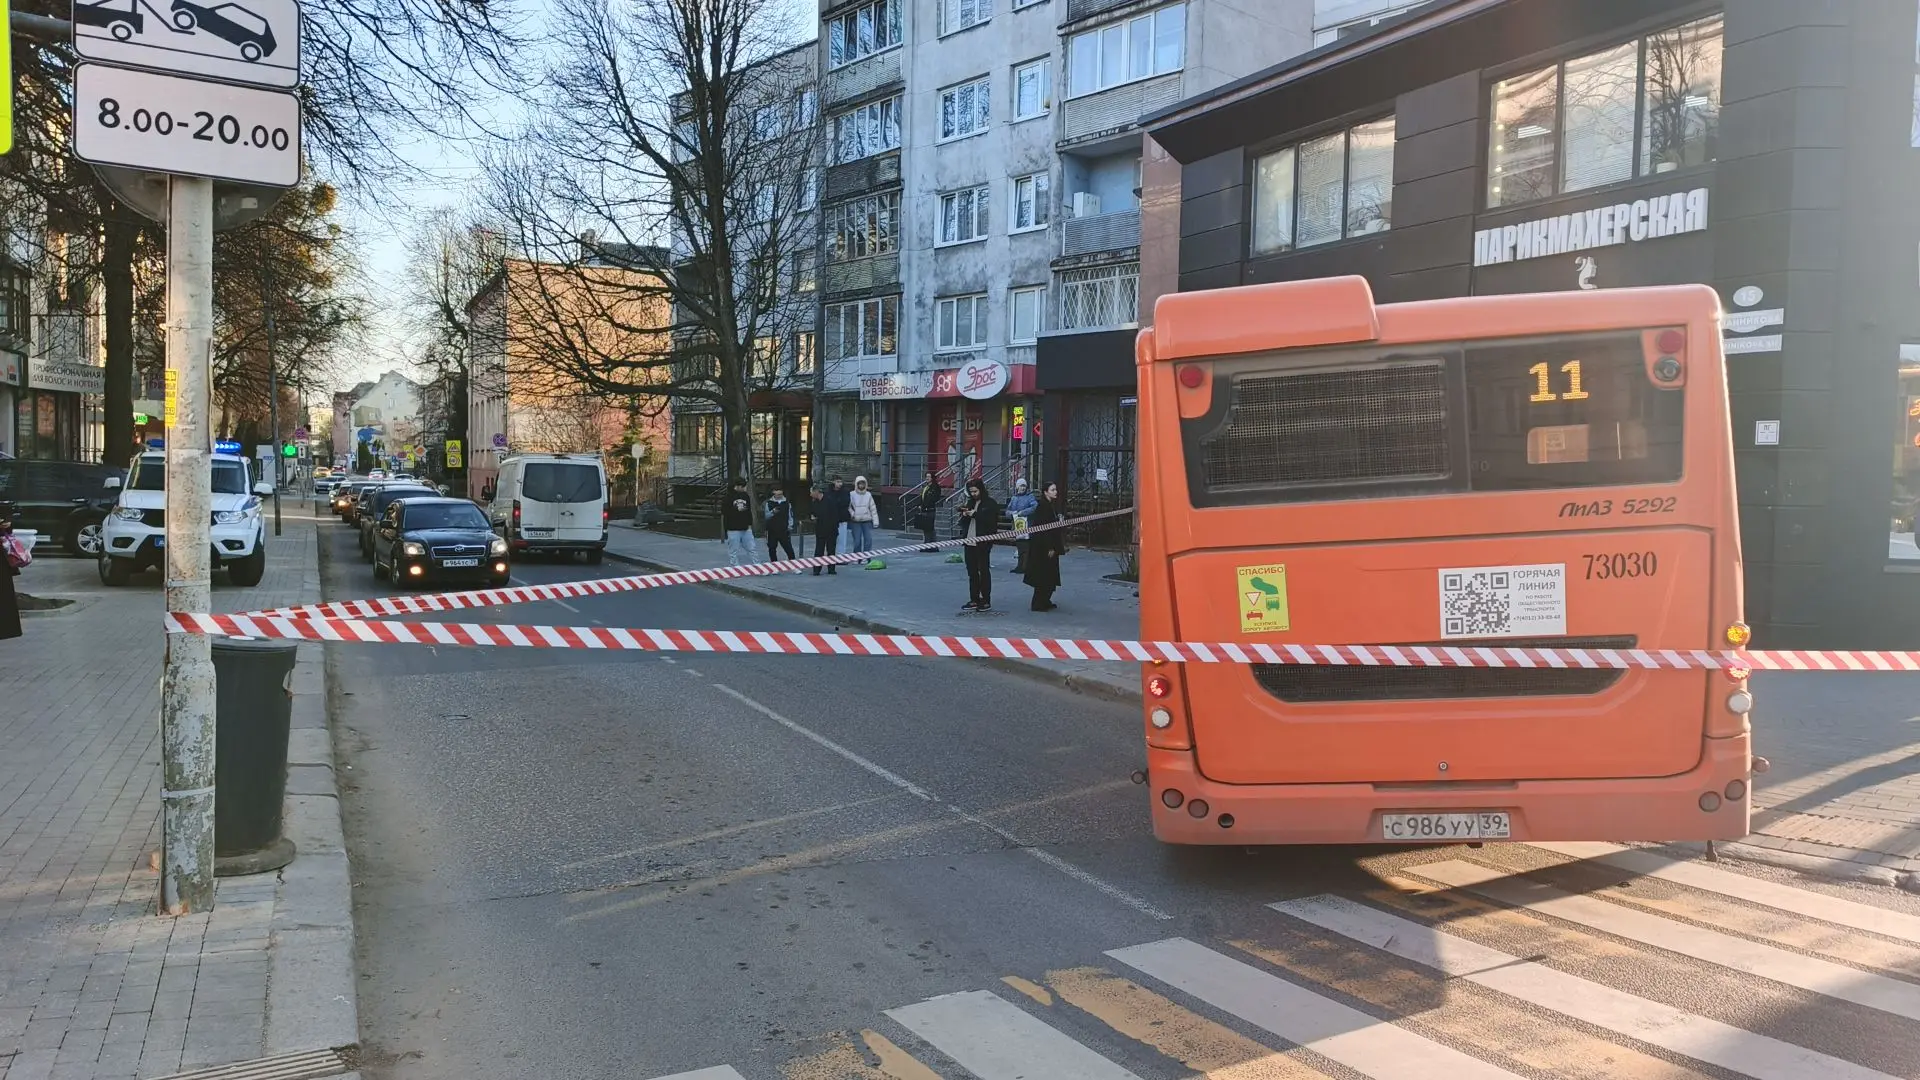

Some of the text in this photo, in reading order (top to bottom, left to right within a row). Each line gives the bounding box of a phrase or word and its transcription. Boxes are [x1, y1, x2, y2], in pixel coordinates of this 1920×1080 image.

[98, 97, 289, 151] 8.00-20.00
[1474, 188, 1708, 267] ПАРИКМАХЕРСКАЯ
[1740, 290, 1756, 302] 15
[34, 363, 100, 378] ПРОФЕССИОНАЛЬНАЯ
[965, 365, 998, 390] Эрос
[45, 376, 66, 385] ВОЛОС
[67, 378, 73, 386] И
[74, 379, 99, 388] НОГТЕЙ
[1529, 360, 1589, 401] 11
[871, 385, 919, 396] ВЗРОСЛЫХ
[1622, 497, 1677, 514] 5292
[1239, 566, 1284, 576] СПАСИБО
[1582, 551, 1658, 580] 73030
[1513, 569, 1561, 579] ГОРЯЧАЯ
[1518, 582, 1556, 592] ЛИНИЯ
[1481, 814, 1503, 830] 39
